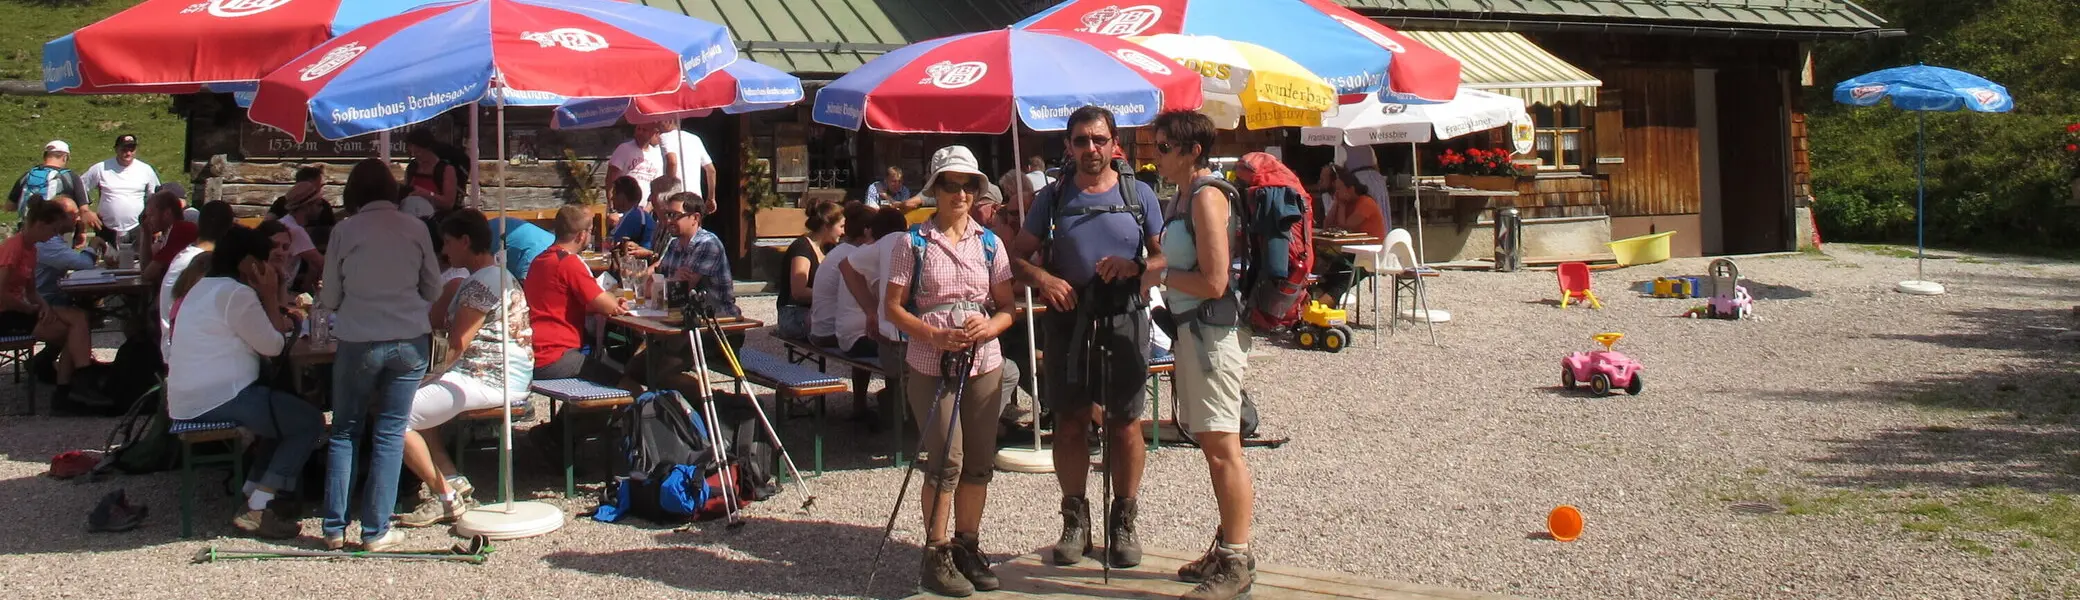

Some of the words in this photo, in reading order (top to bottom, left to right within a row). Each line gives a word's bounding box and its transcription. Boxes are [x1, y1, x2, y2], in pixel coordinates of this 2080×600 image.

[332, 102, 406, 124] Hofbrauhaus
[1029, 103, 1081, 119] Hofbrauhau
[1369, 130, 1408, 140] Weissbier
